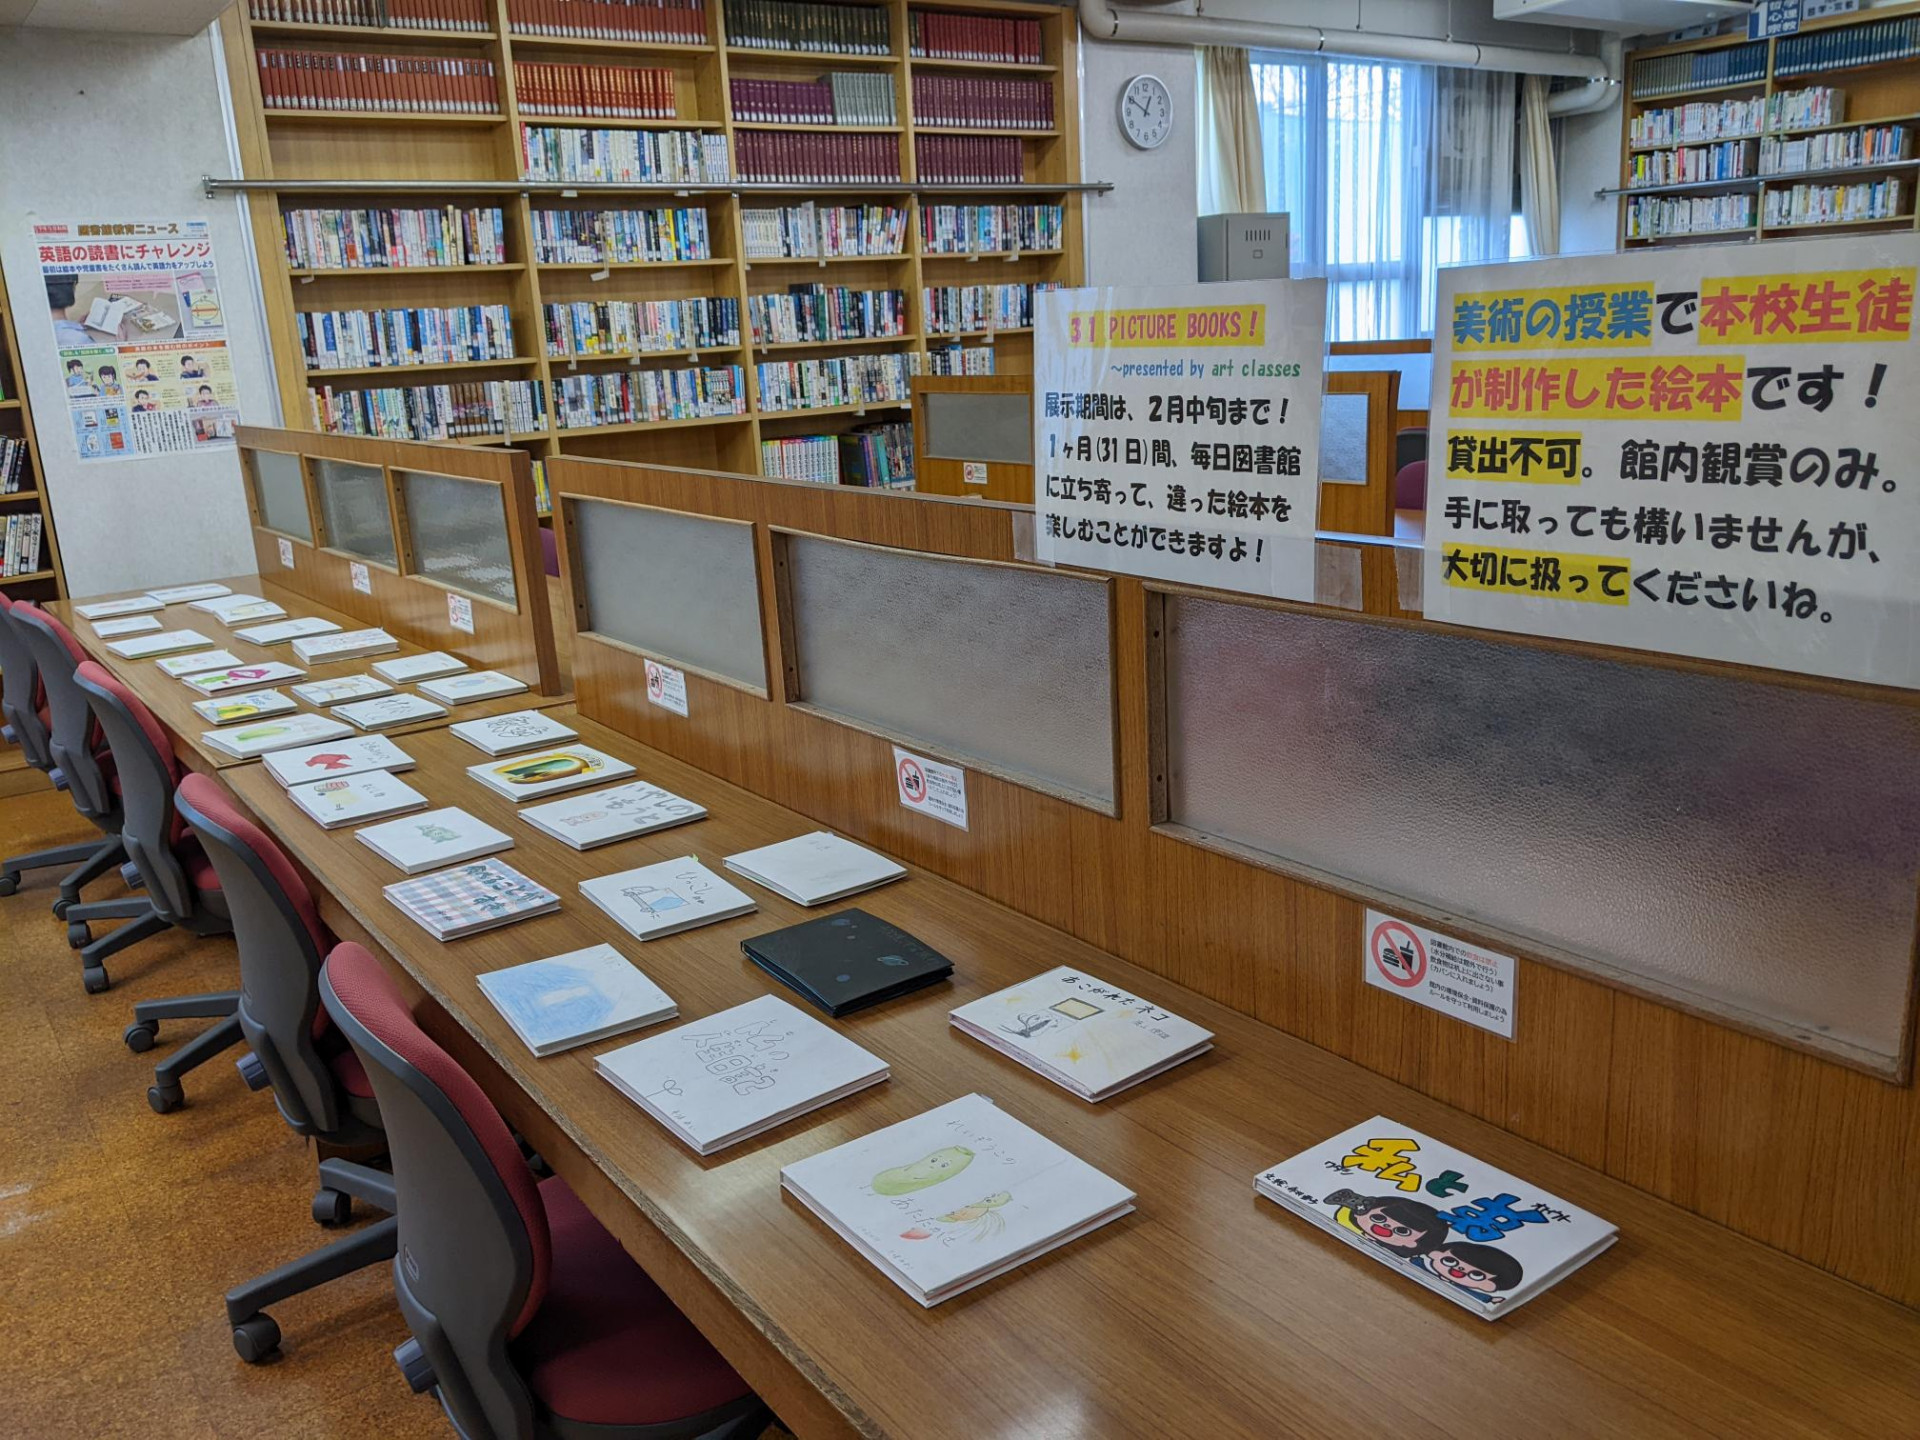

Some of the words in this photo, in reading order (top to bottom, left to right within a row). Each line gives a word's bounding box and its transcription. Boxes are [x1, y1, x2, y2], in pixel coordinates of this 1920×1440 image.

[38, 242, 211, 263] 英語の読書にチャレンジ
[1109, 313, 1177, 341] PICTURE
[1452, 276, 1911, 345] 美術の授業で本校生徒
[1189, 359, 1205, 379] by
[1211, 359, 1234, 377] art
[1241, 359, 1301, 378] classes
[1450, 362, 1889, 414] が制作した絵本です！
[1447, 435, 1593, 480] 貸出不可。
[1620, 438, 1897, 494] 館内観賞のみ。
[1045, 474, 1292, 523] に立ち寄って、違った絵本を
[1045, 513, 1264, 564] 楽しむことができますよ！
[1444, 496, 1881, 565] 手に取っても構いませんが、
[1441, 548, 1833, 624] 大切に扱ってくださいね。
